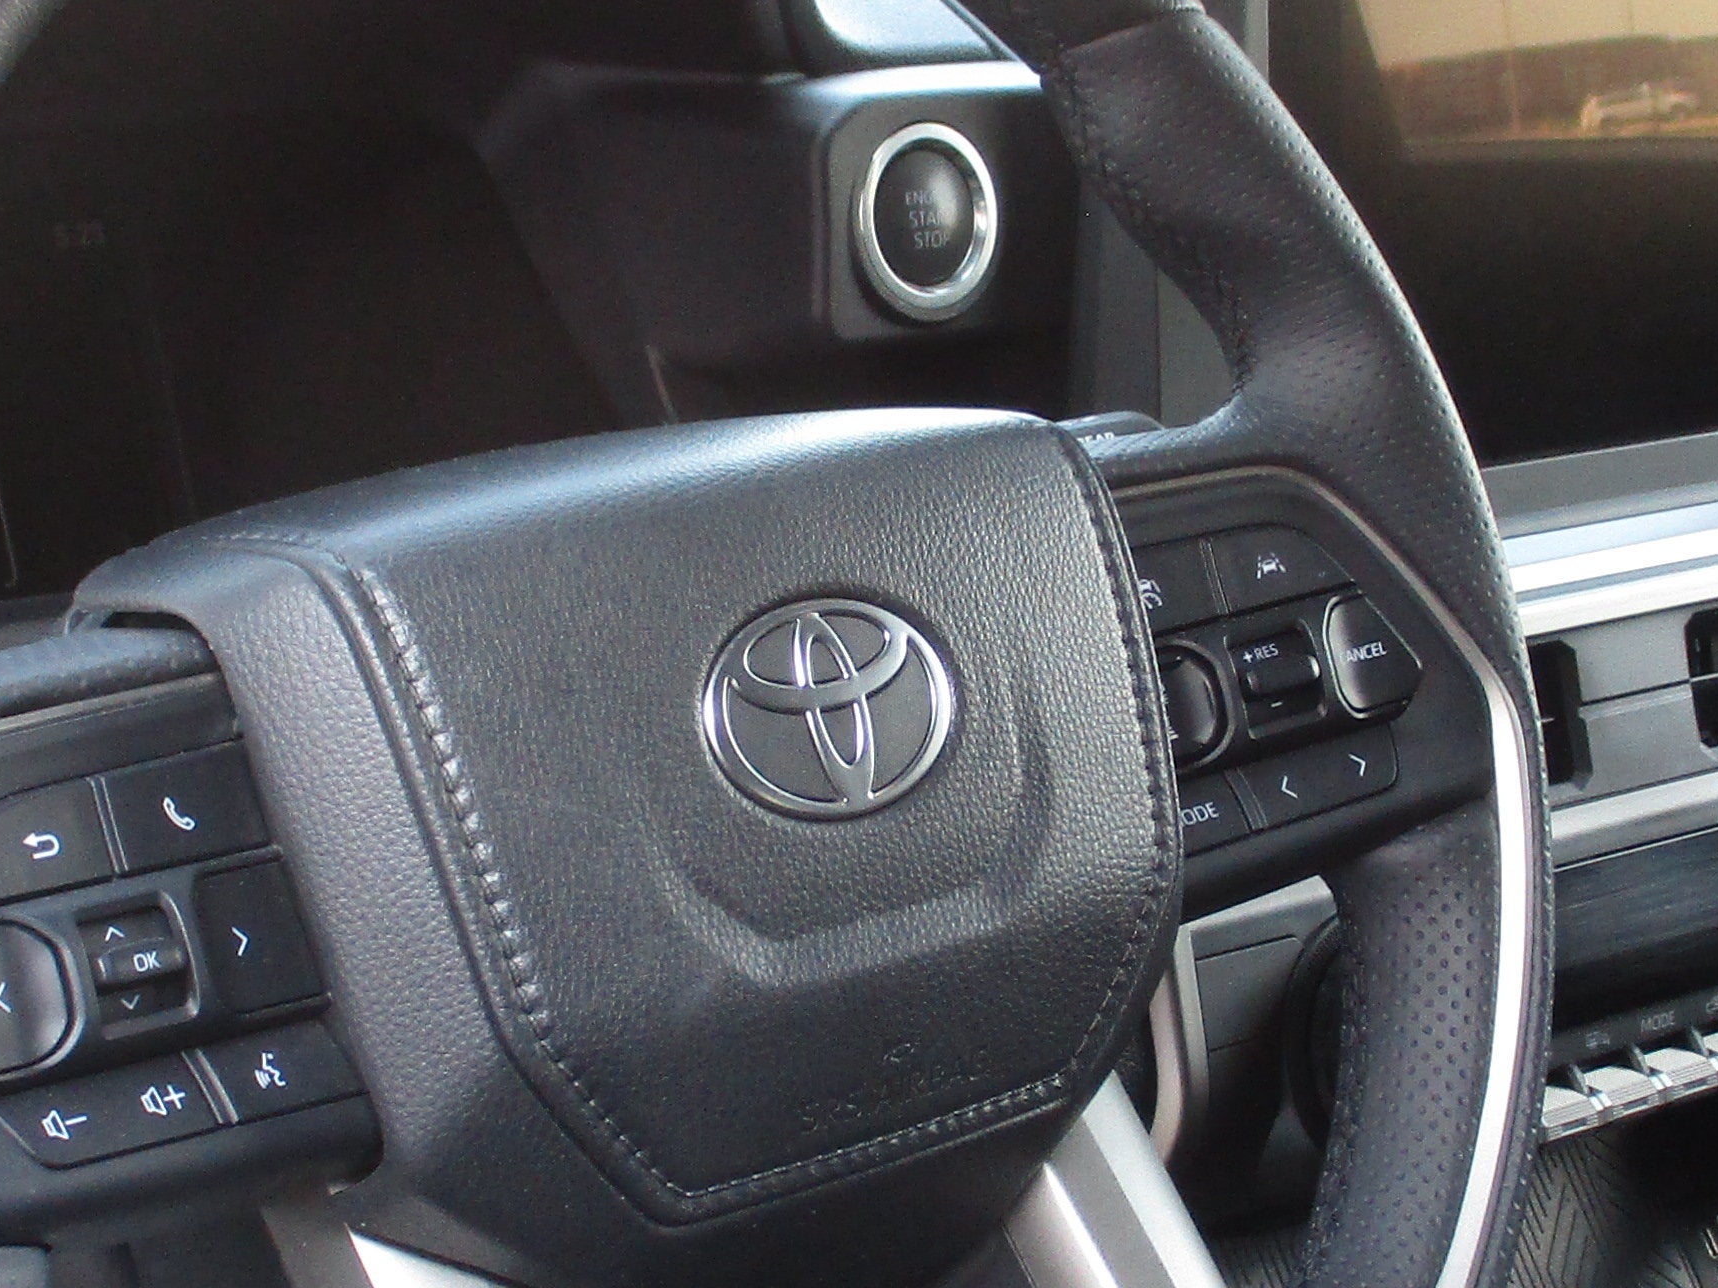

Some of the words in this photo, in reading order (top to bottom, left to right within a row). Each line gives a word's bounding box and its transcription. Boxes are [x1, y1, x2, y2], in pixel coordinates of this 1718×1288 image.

[1181, 801, 1219, 827] ODE
[133, 948, 161, 973] OK
[1640, 1012, 1676, 1033] MODE
